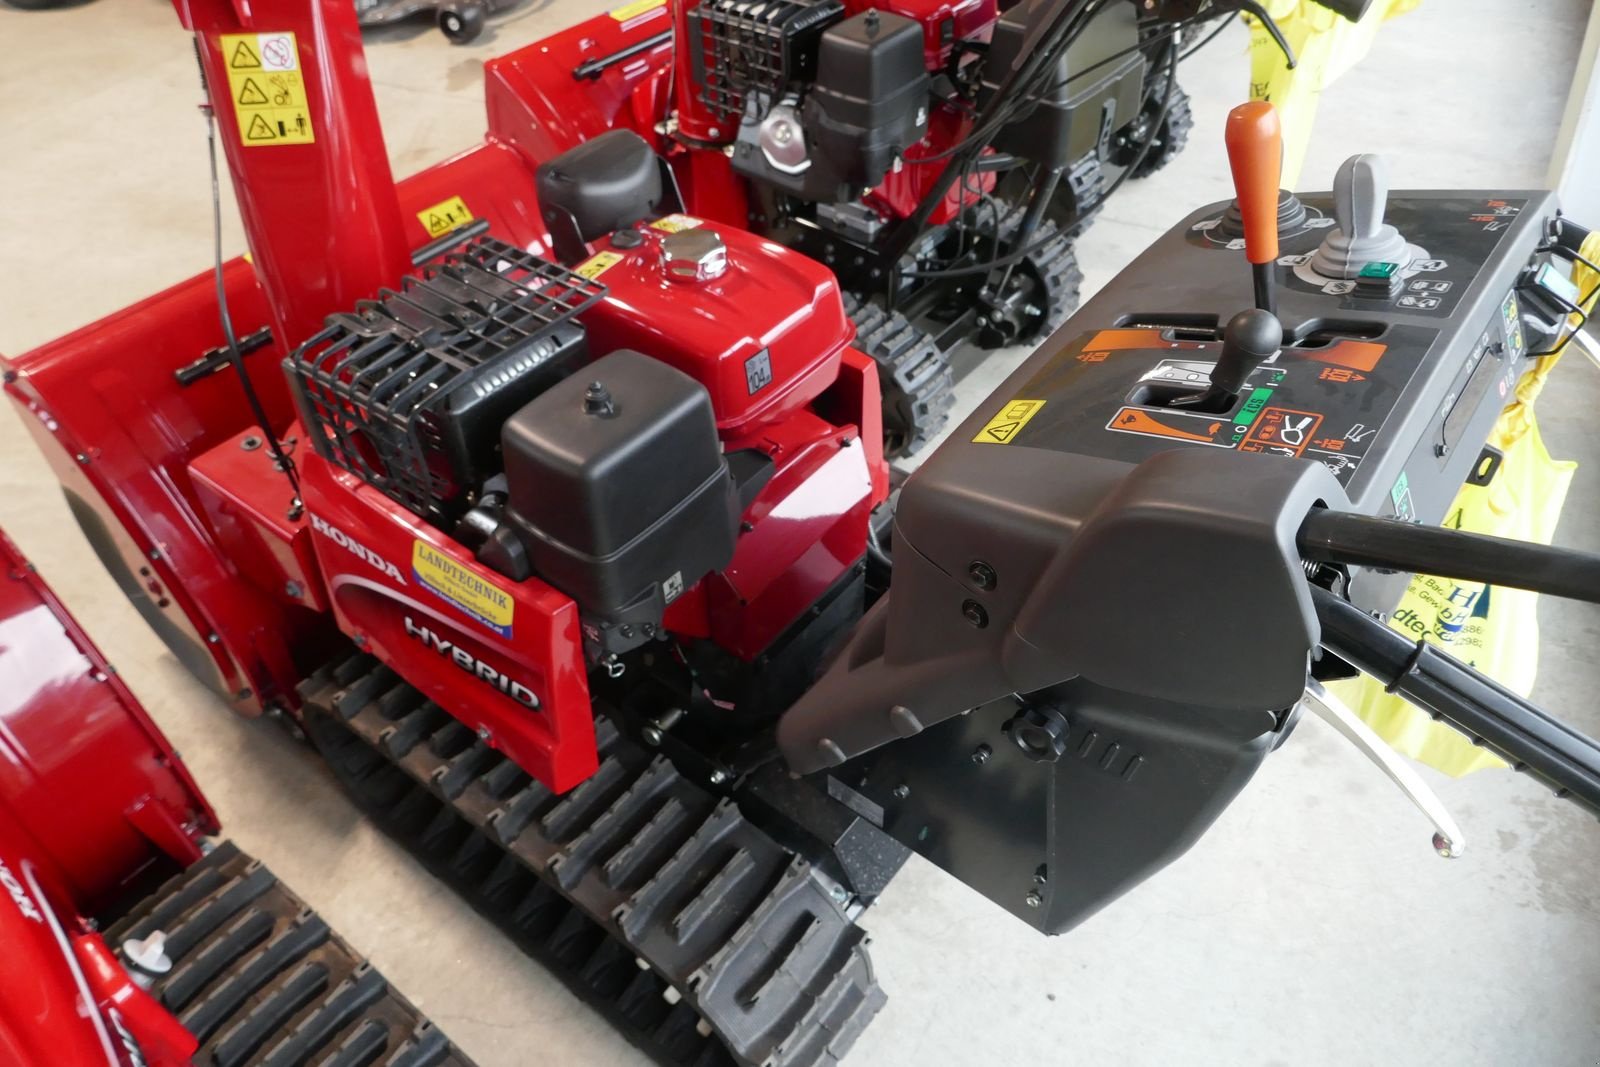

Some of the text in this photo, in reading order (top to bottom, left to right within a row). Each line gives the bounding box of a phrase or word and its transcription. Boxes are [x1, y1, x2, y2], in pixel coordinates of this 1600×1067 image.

[310, 512, 408, 586] HONDA
[418, 545, 508, 610] LANDTECHNIK
[404, 616, 542, 708] HYBRID
